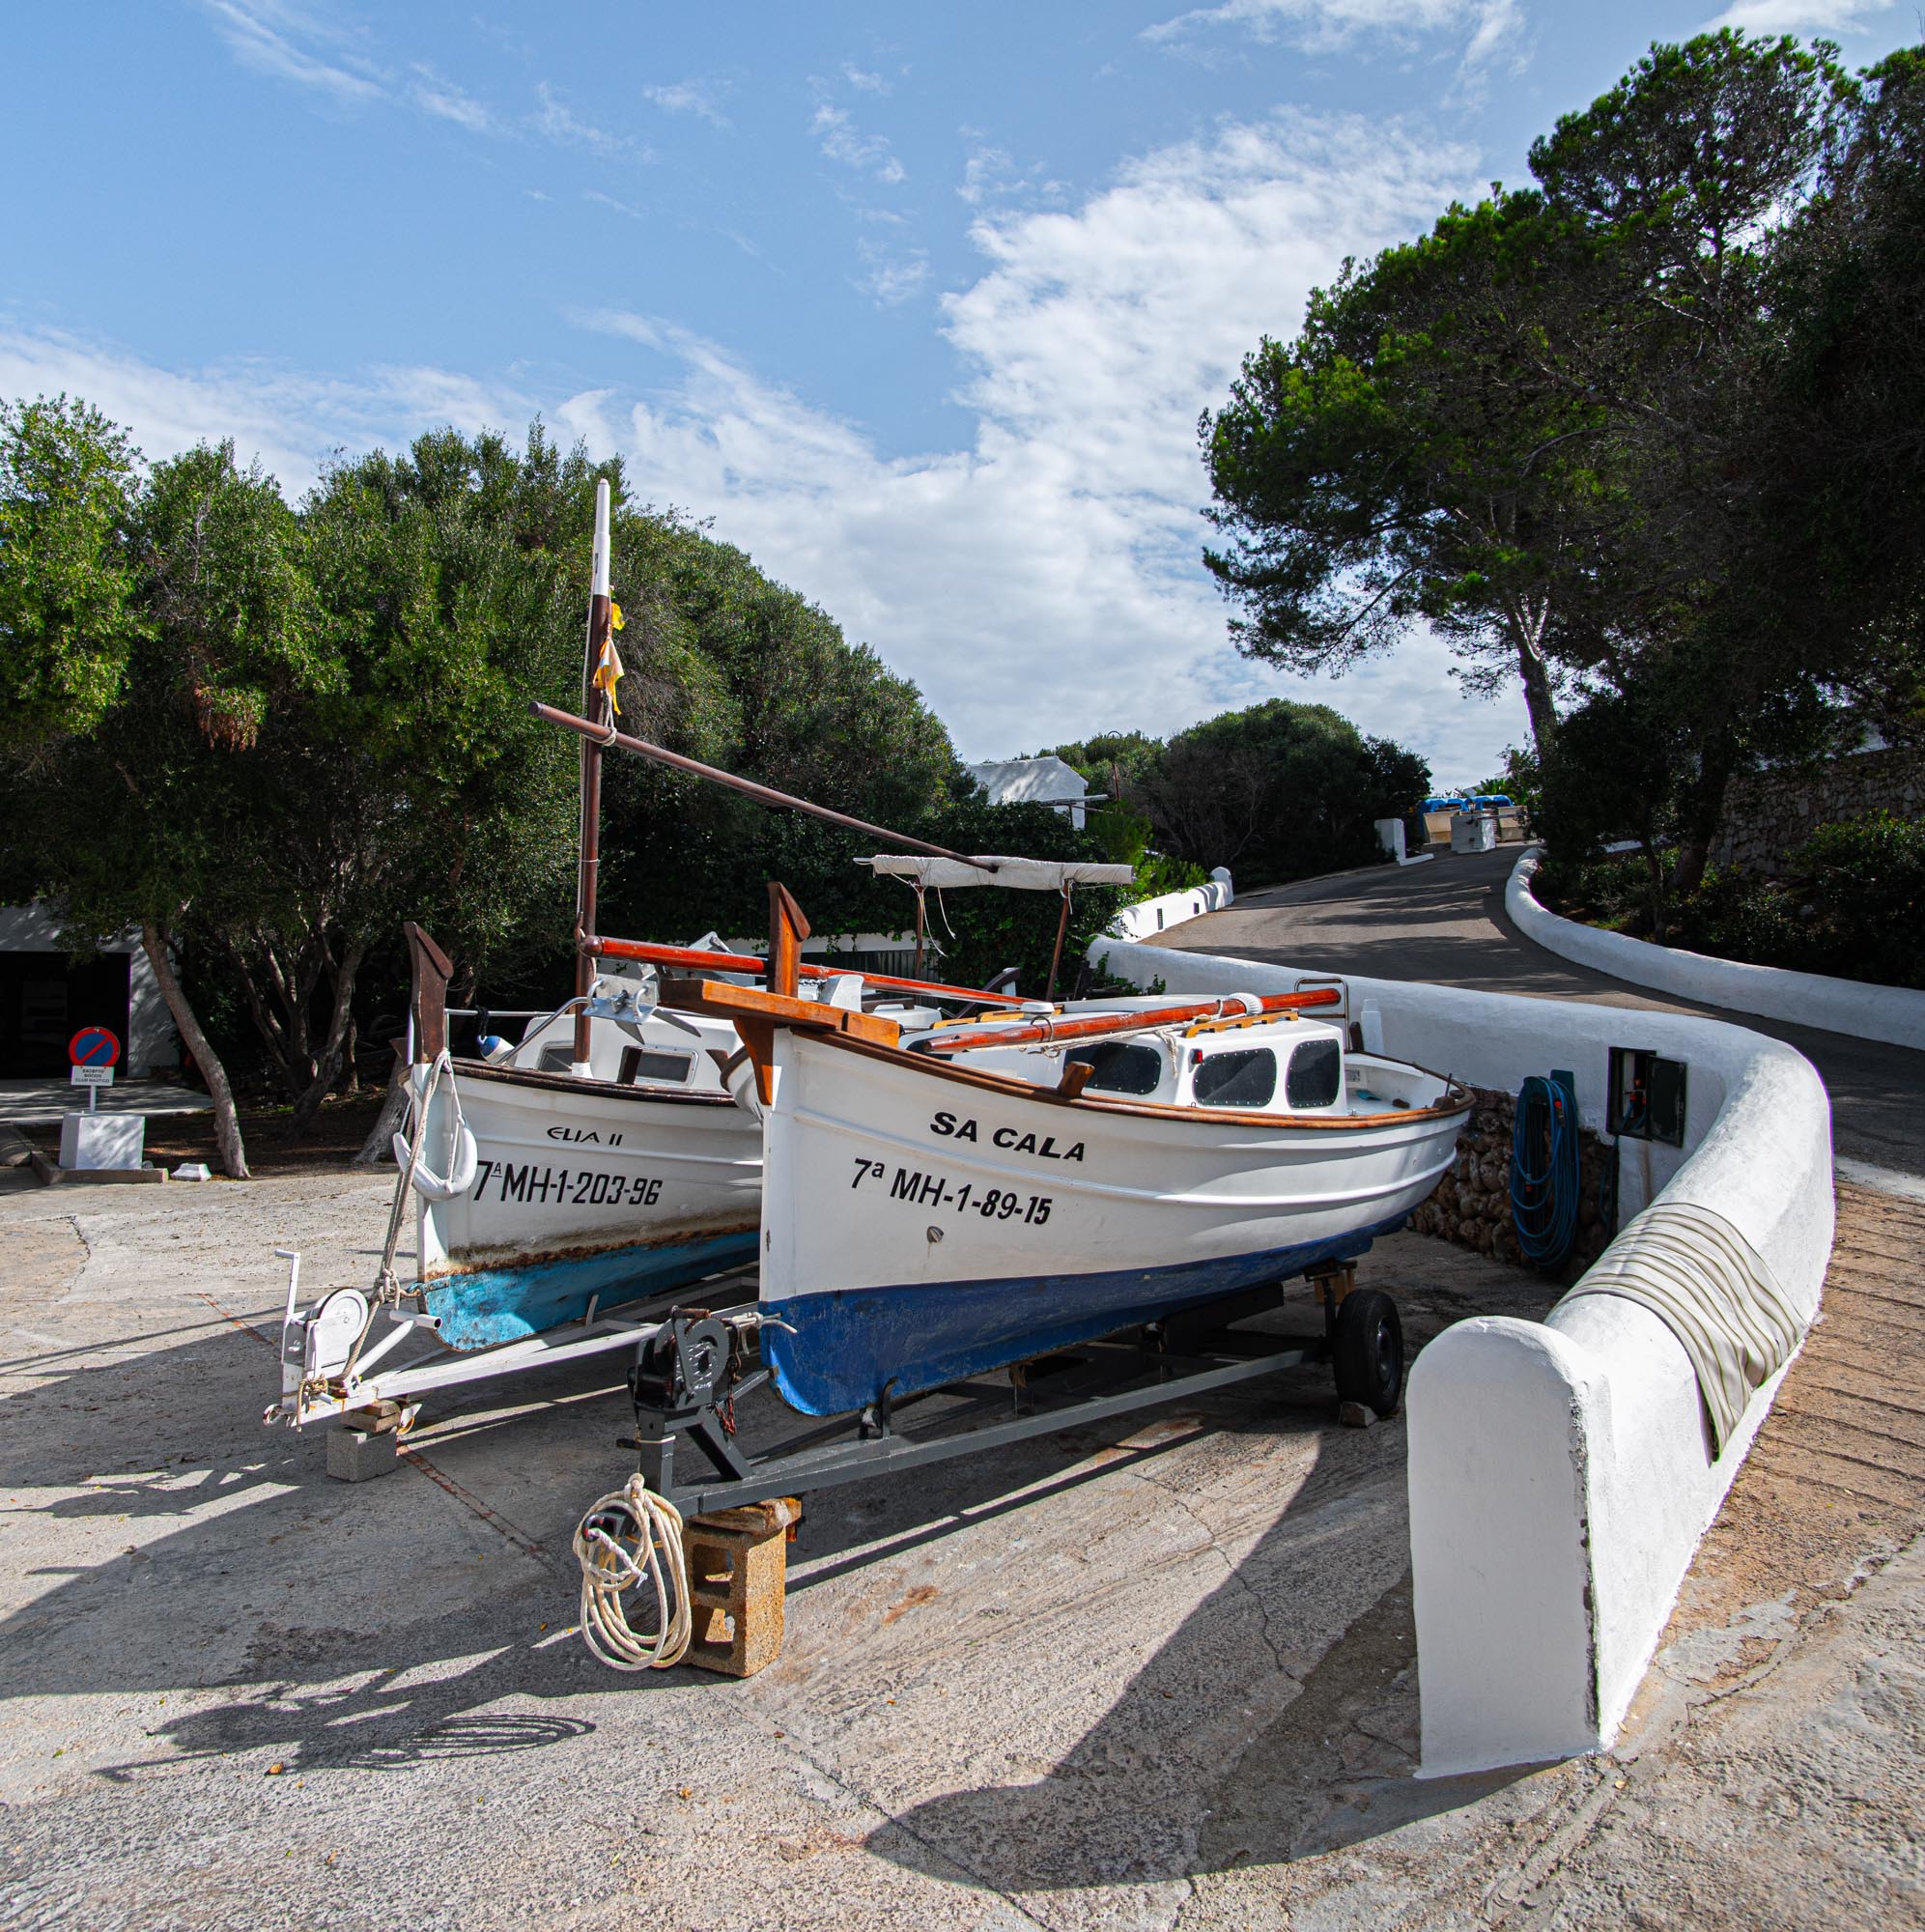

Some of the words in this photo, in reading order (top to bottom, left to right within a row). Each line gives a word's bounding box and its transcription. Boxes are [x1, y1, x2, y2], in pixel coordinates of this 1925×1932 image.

[547, 1126, 600, 1144] ELIA
[609, 1133, 623, 1146] II
[929, 1111, 977, 1143] SA
[992, 1127, 1085, 1162] CALA
[890, 1168, 1053, 1225] MH-1-89-15
